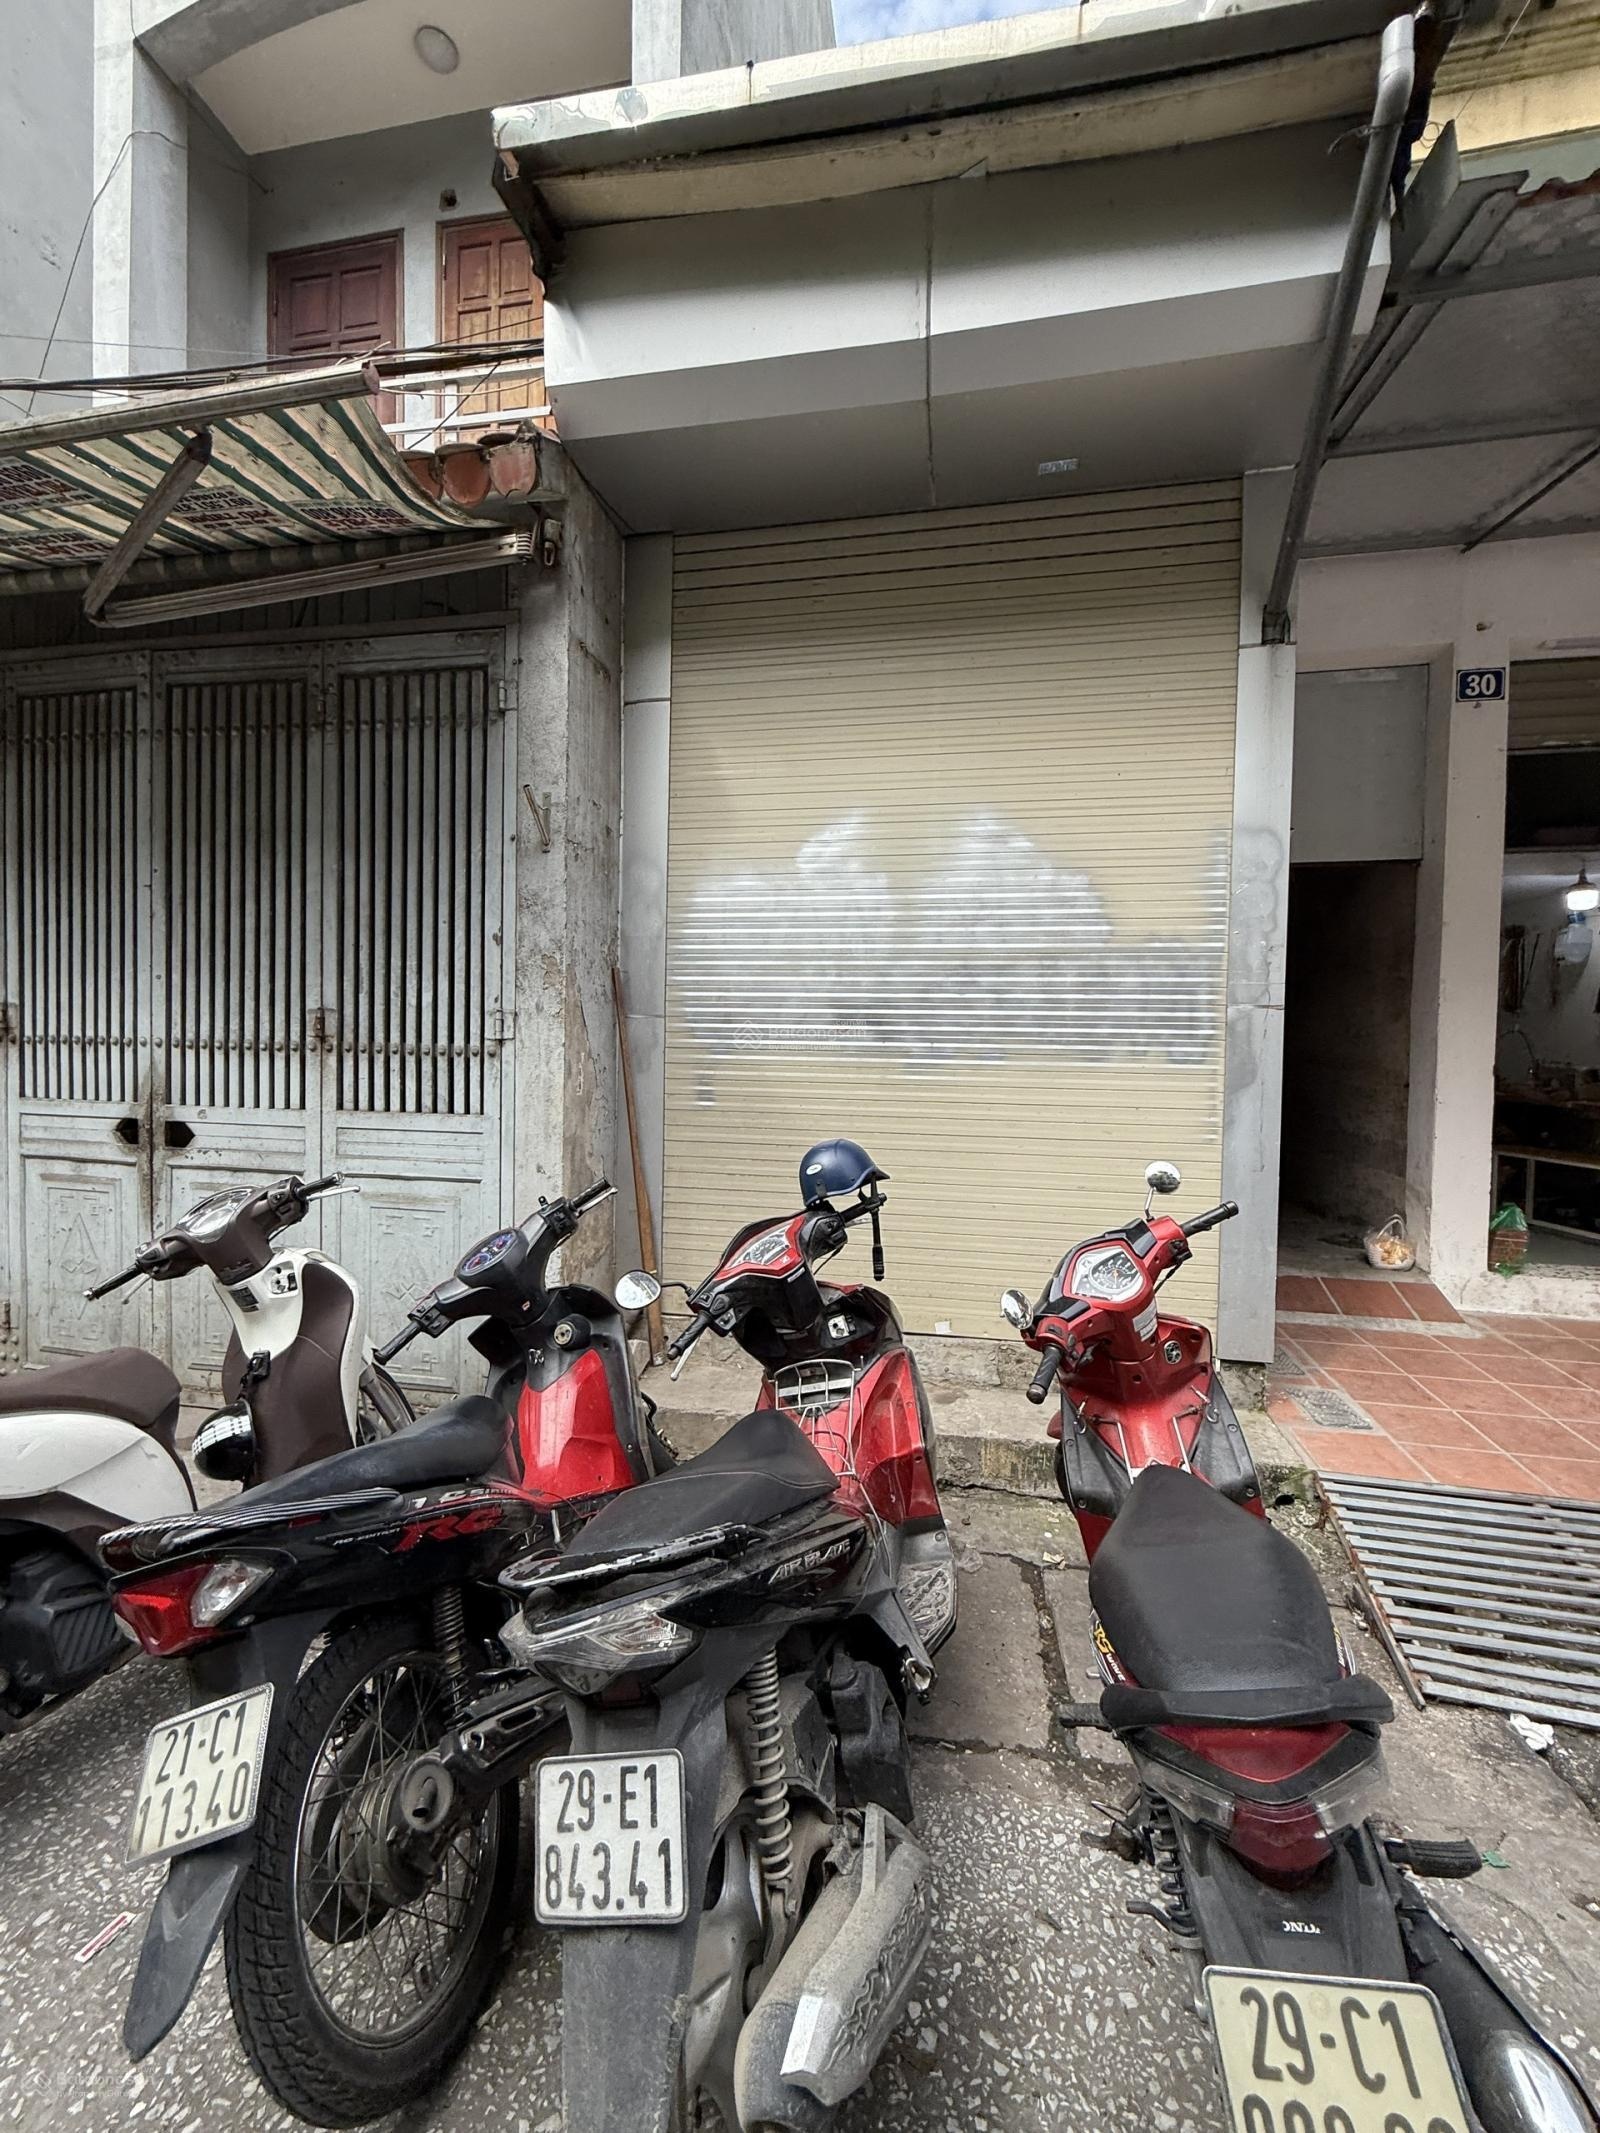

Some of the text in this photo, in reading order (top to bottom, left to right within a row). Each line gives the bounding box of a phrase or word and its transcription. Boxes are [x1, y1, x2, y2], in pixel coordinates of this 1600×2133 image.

[1465, 673, 1496, 697] 30
[156, 1701, 248, 1785] 21-C1
[136, 1760, 251, 1850] 113.40
[557, 1763, 658, 1834] 29-E1
[545, 1838, 672, 1911] 843.41
[1240, 1985, 1422, 2100] 29-C1
